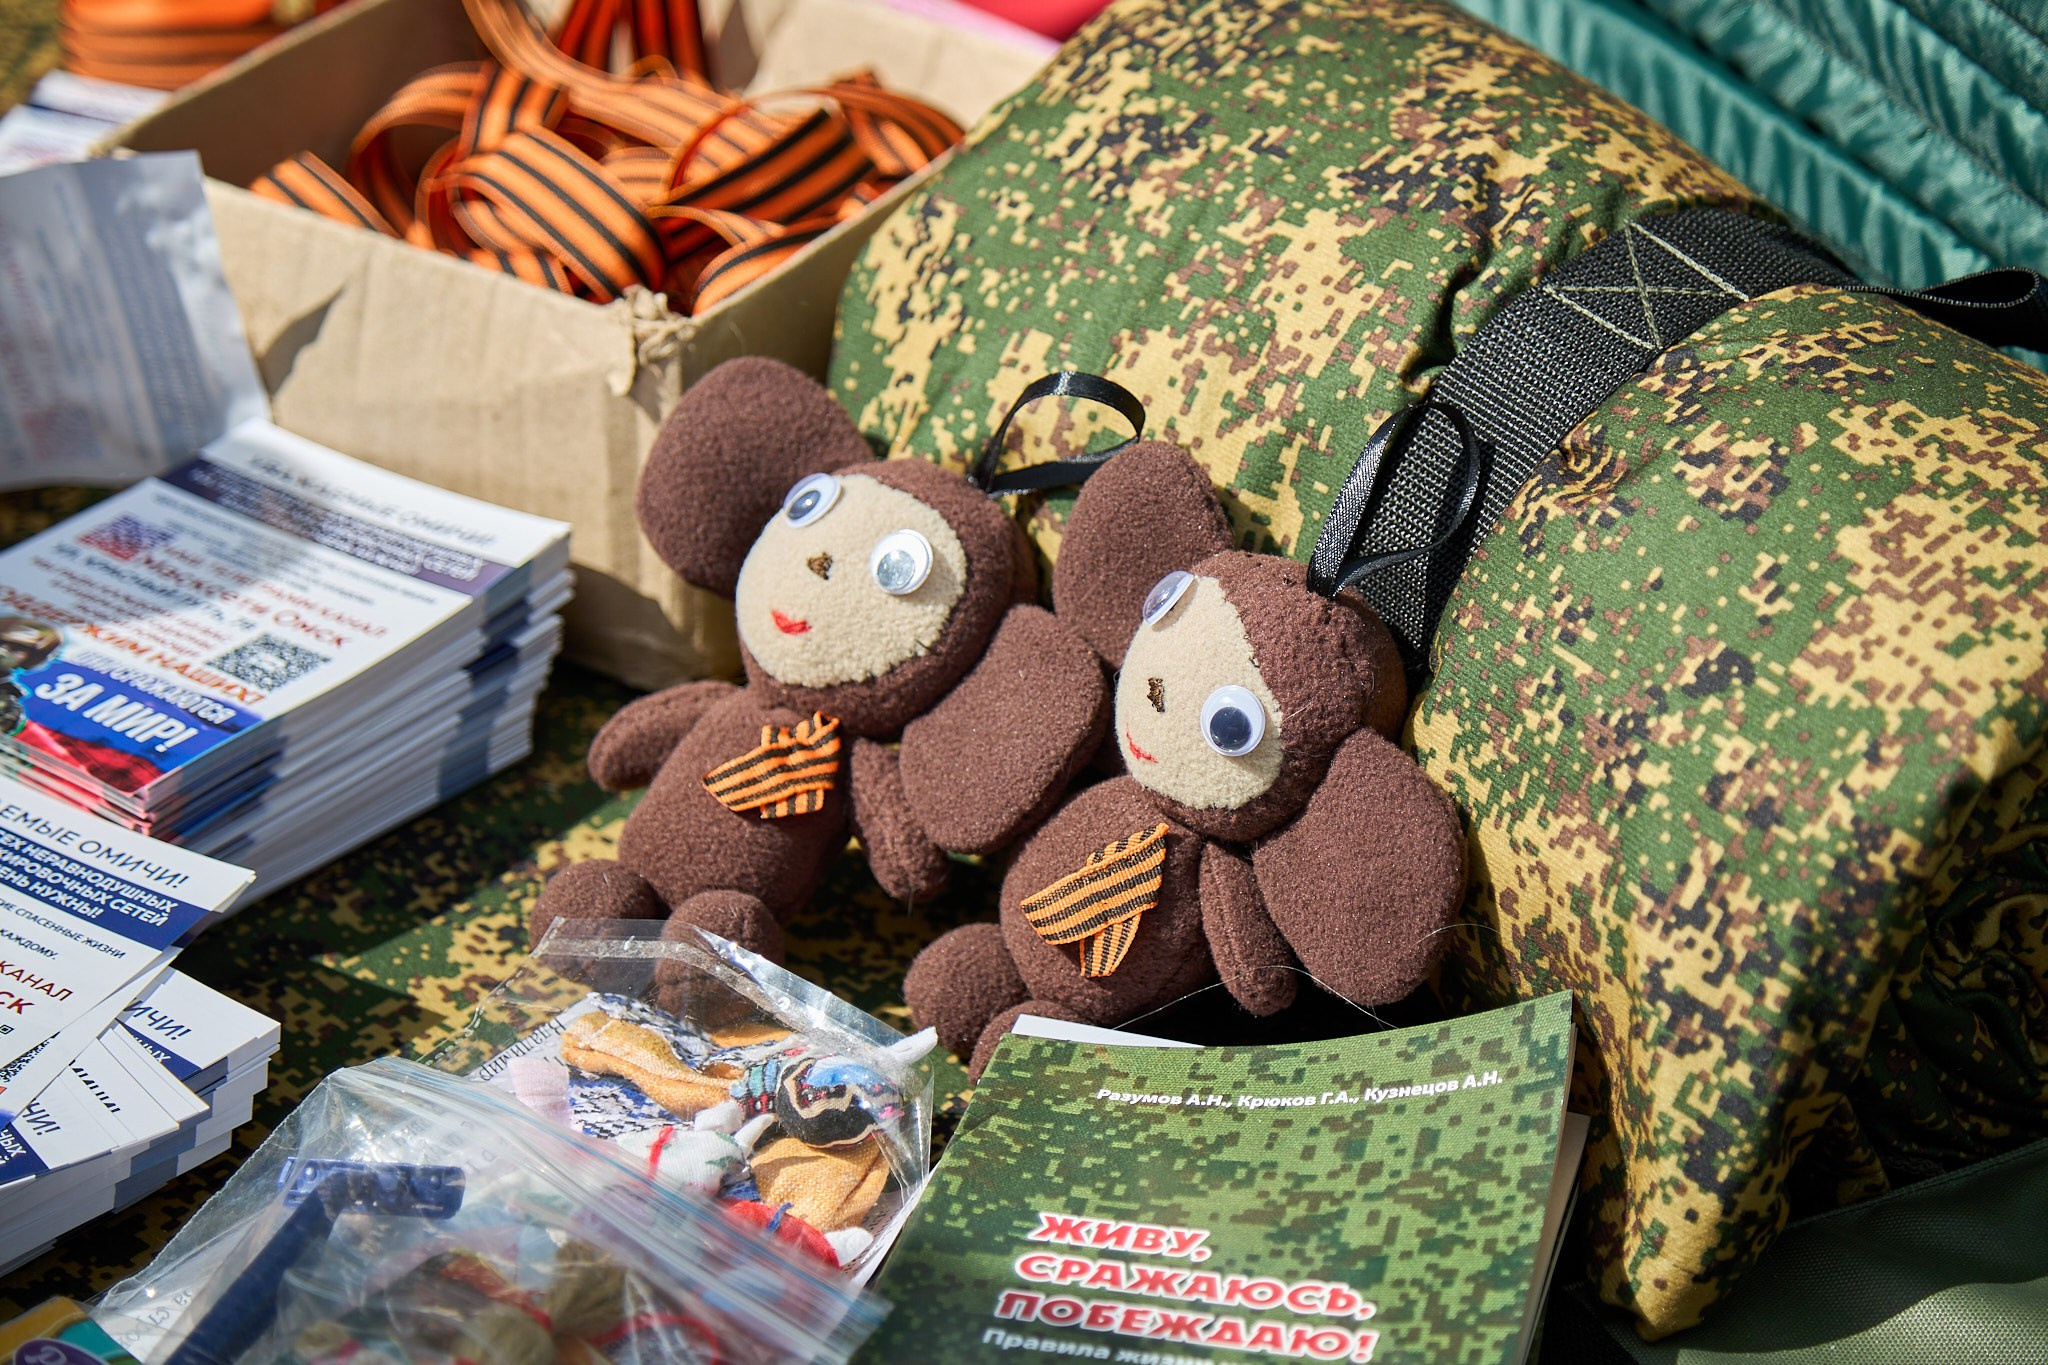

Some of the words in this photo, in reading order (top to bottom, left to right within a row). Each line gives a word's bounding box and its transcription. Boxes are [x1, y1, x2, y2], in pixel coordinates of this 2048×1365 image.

[34, 672, 105, 712] ЗА
[82, 692, 199, 753] МИР!
[21, 843, 179, 914] НЕРАВНОДУШНЫХ
[78, 839, 190, 889] ОМИЧИ!
[28, 880, 105, 919] НУЖНЫ!
[109, 897, 170, 928] СЕТЕЙ
[15, 907, 84, 942] СПАСЕННЫЕ
[83, 936, 127, 960] ЖИЗНИ
[0, 960, 74, 1002] КАНАЛ
[123, 998, 193, 1040] ИЧИ!
[1096, 1088, 1184, 1106] Разумов
[1185, 1094, 1233, 1108] А.Н.,
[1237, 1095, 1316, 1110] Крюков
[1320, 1091, 1360, 1105] Г.А.,
[1364, 1079, 1459, 1103] Кузнецов
[1462, 1070, 1503, 1089] А.Н.
[22, 1098, 62, 1136] ЧИ!
[1029, 1211, 1212, 1262] ЖИВУ,
[1014, 1252, 1378, 1321] СРАЖАЮСЬ,
[981, 1327, 1111, 1360] Правила
[993, 1289, 1380, 1363] ПОБЕЖДАЮ!
